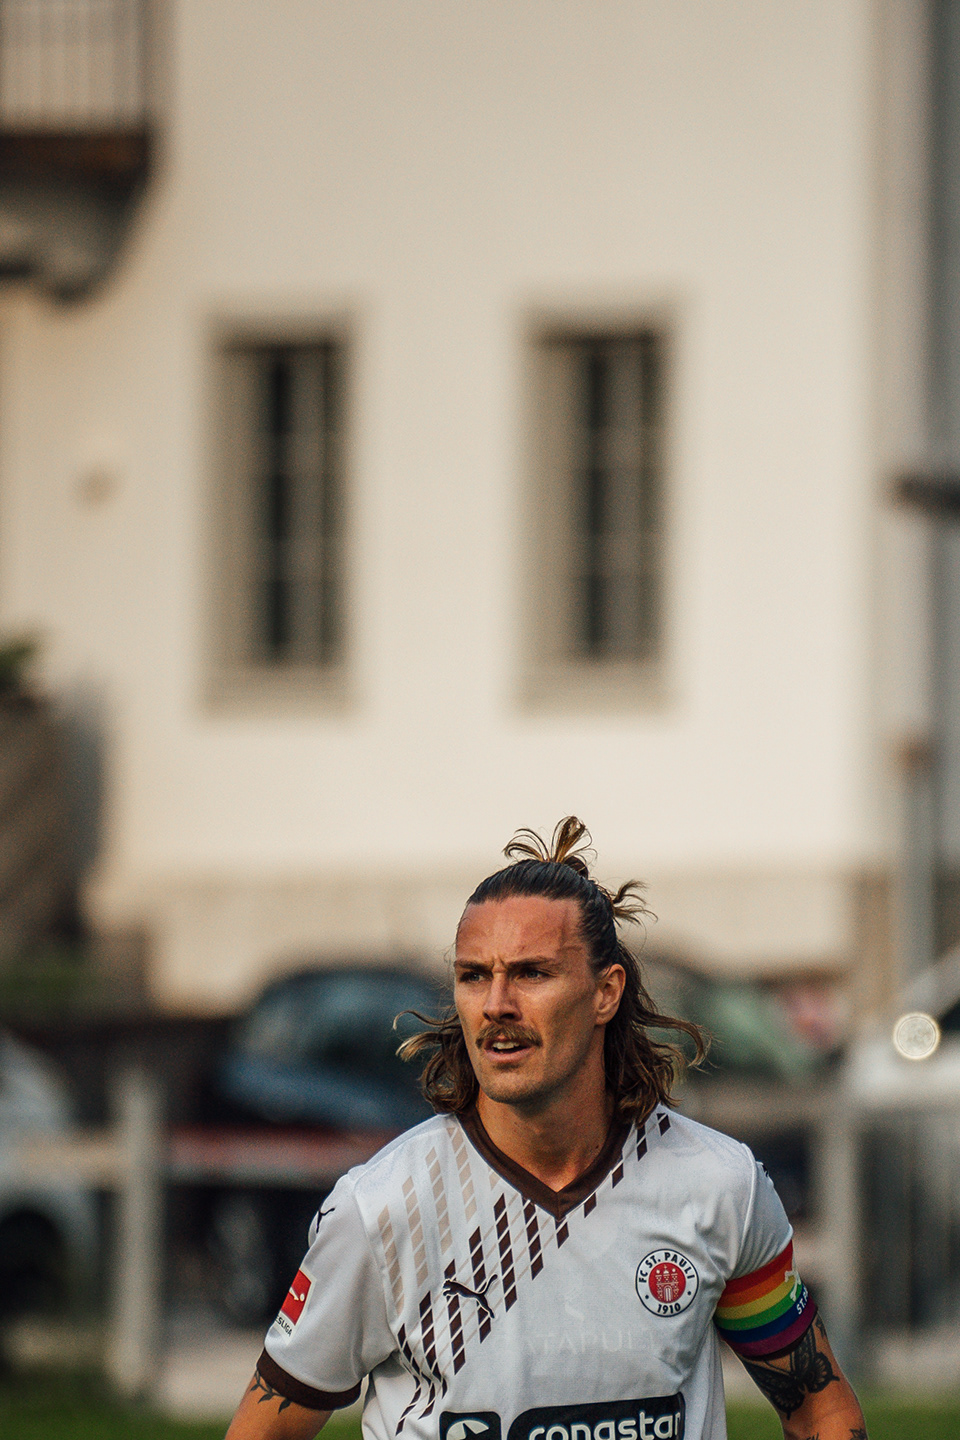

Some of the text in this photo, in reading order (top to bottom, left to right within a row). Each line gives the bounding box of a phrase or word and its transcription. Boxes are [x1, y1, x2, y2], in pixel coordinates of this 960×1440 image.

[639, 1252, 695, 1283] FC ST. PAULI
[657, 1302, 681, 1314] 1910
